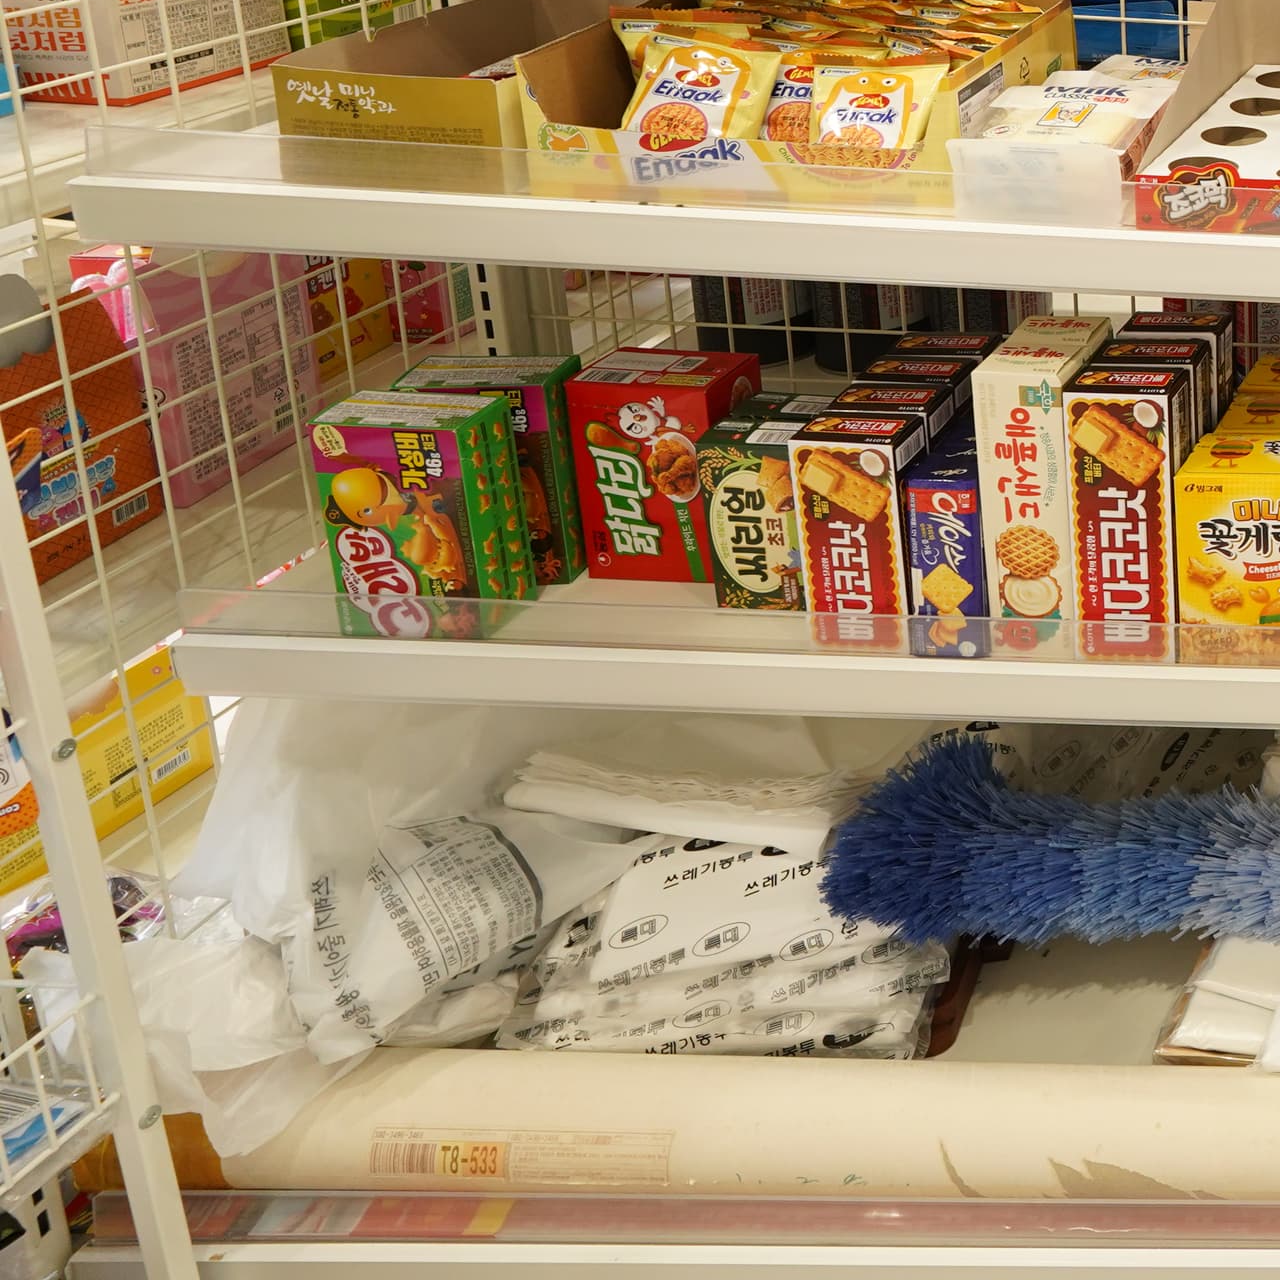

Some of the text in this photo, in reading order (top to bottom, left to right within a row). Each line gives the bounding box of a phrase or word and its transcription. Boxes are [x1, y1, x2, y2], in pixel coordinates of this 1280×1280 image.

[287, 78, 375, 110] 옛날 미니
[358, 96, 397, 116] 약과
[653, 79, 724, 102] Enaak
[392, 430, 430, 491] 가성비
[585, 444, 664, 558] 닭다리
[719, 485, 767, 584] 씨리얼
[766, 516, 787, 549] 초코
[663, 850, 754, 890] 쓰레기봉투
[440, 1144, 499, 1176] T8-533
